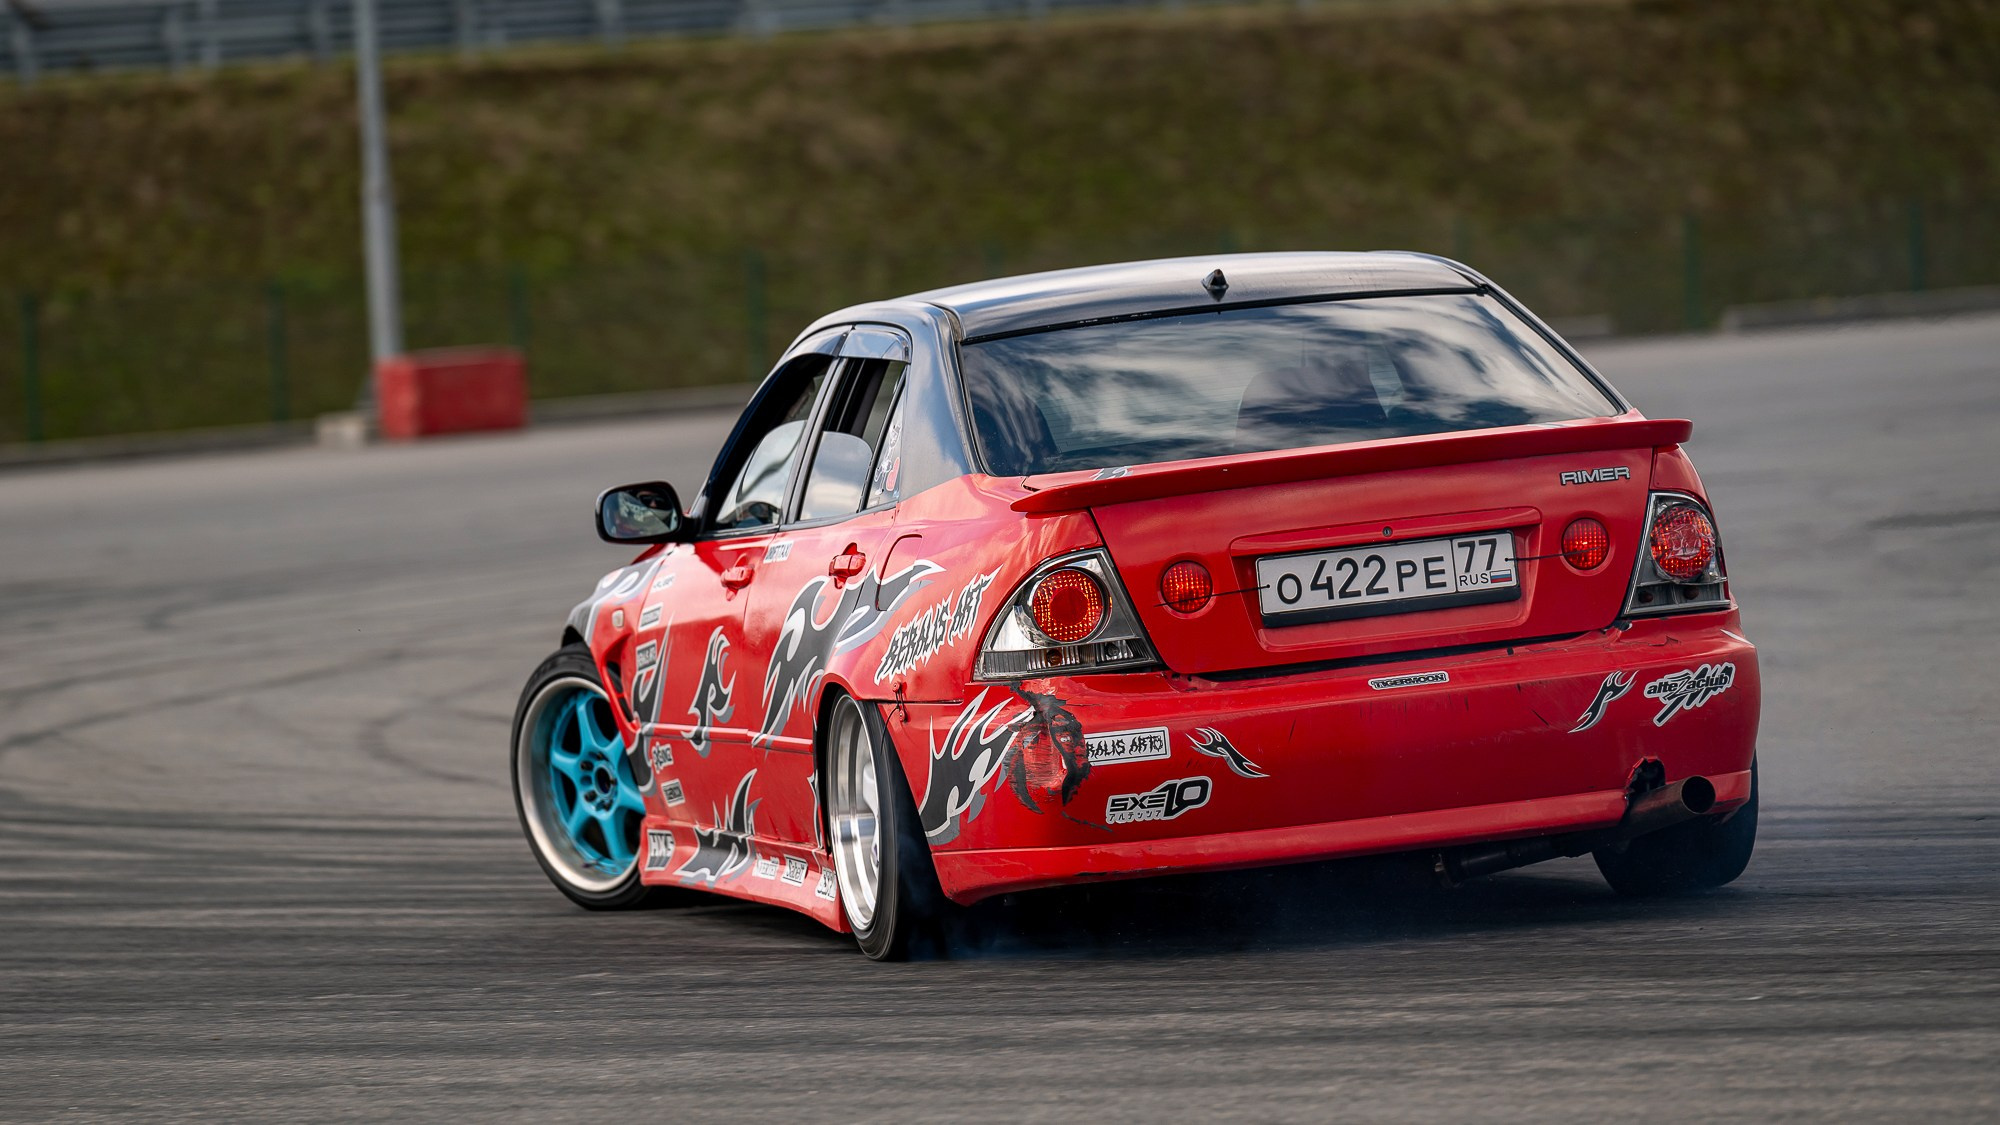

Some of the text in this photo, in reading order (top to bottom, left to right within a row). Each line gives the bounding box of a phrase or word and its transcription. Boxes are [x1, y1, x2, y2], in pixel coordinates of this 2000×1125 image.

[1561, 467, 1630, 485] RIMER
[1457, 537, 1498, 574] 77
[1459, 572, 1490, 587] RUS
[948, 573, 995, 644] ART
[1371, 672, 1447, 689] TIGERMOON
[1109, 778, 1210, 817] SXE10
